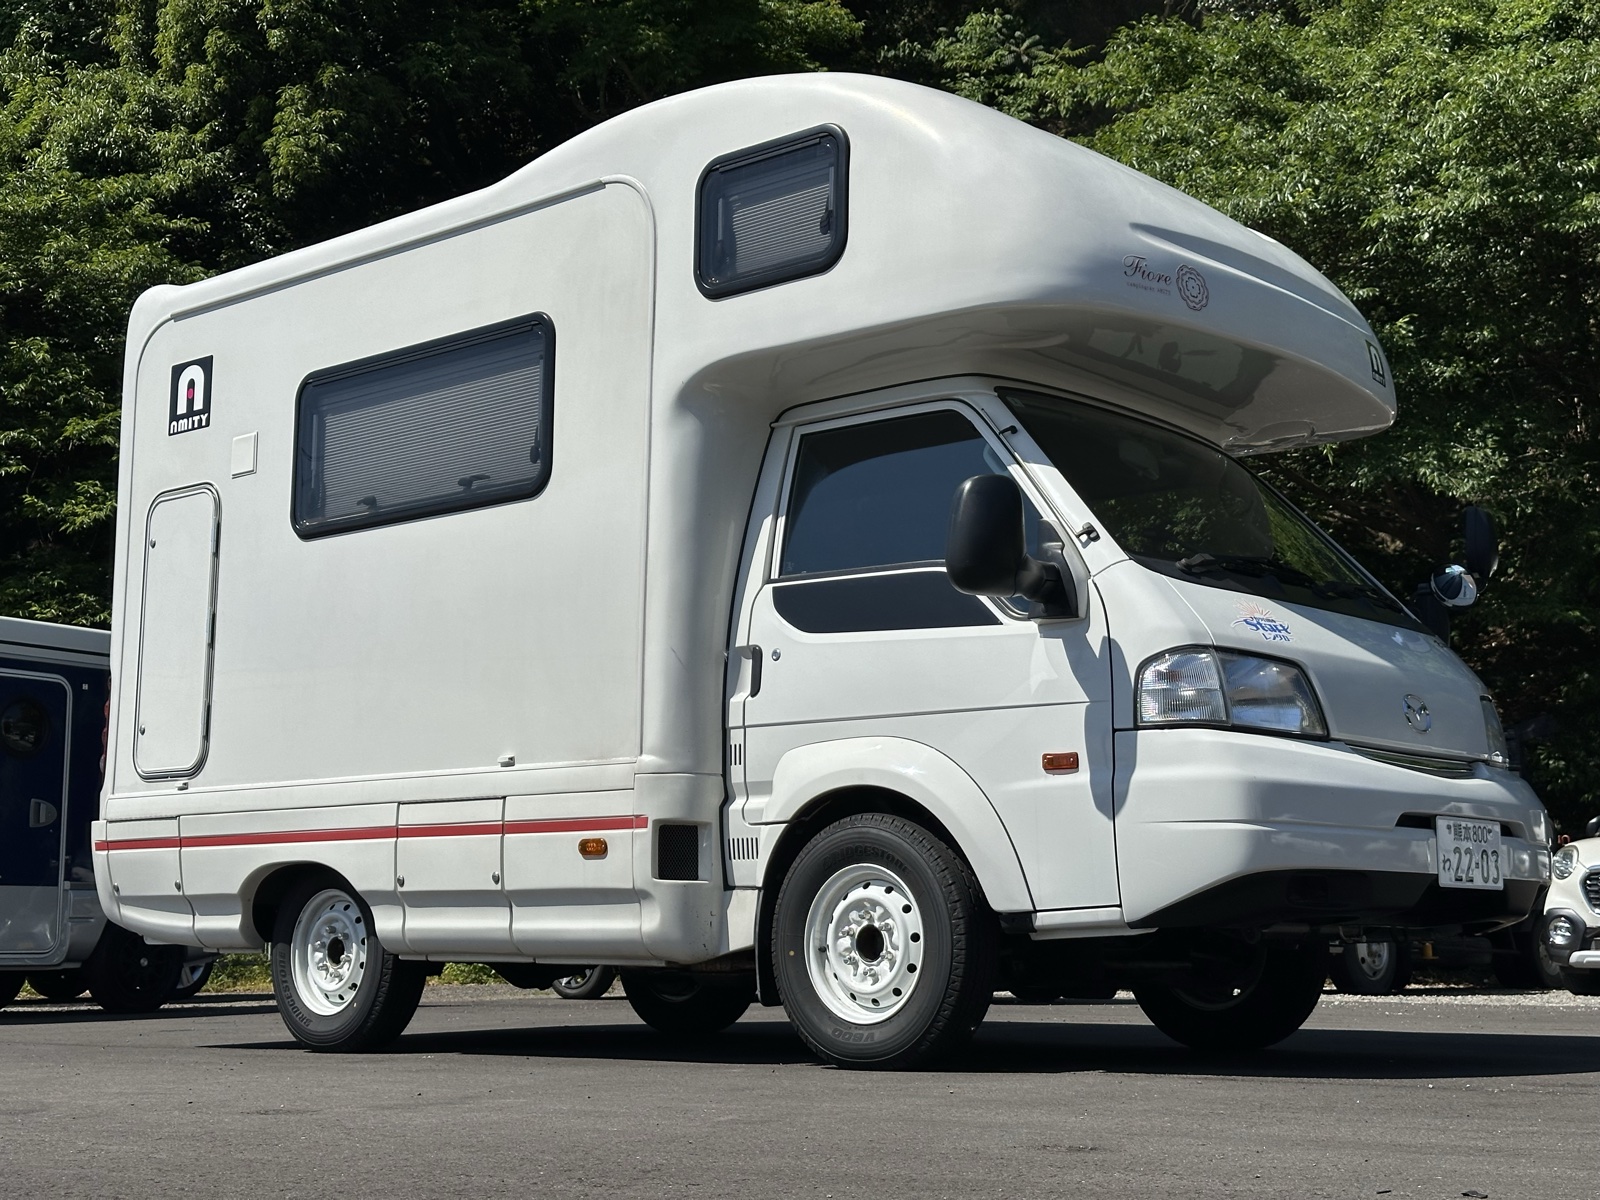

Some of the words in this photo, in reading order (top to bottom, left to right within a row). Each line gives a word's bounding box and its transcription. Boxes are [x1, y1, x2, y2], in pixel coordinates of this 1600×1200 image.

[1123, 255, 1172, 285] Fiore
[822, 844, 912, 874] BRIDGESTONE
[1453, 846, 1500, 884] 22-03
